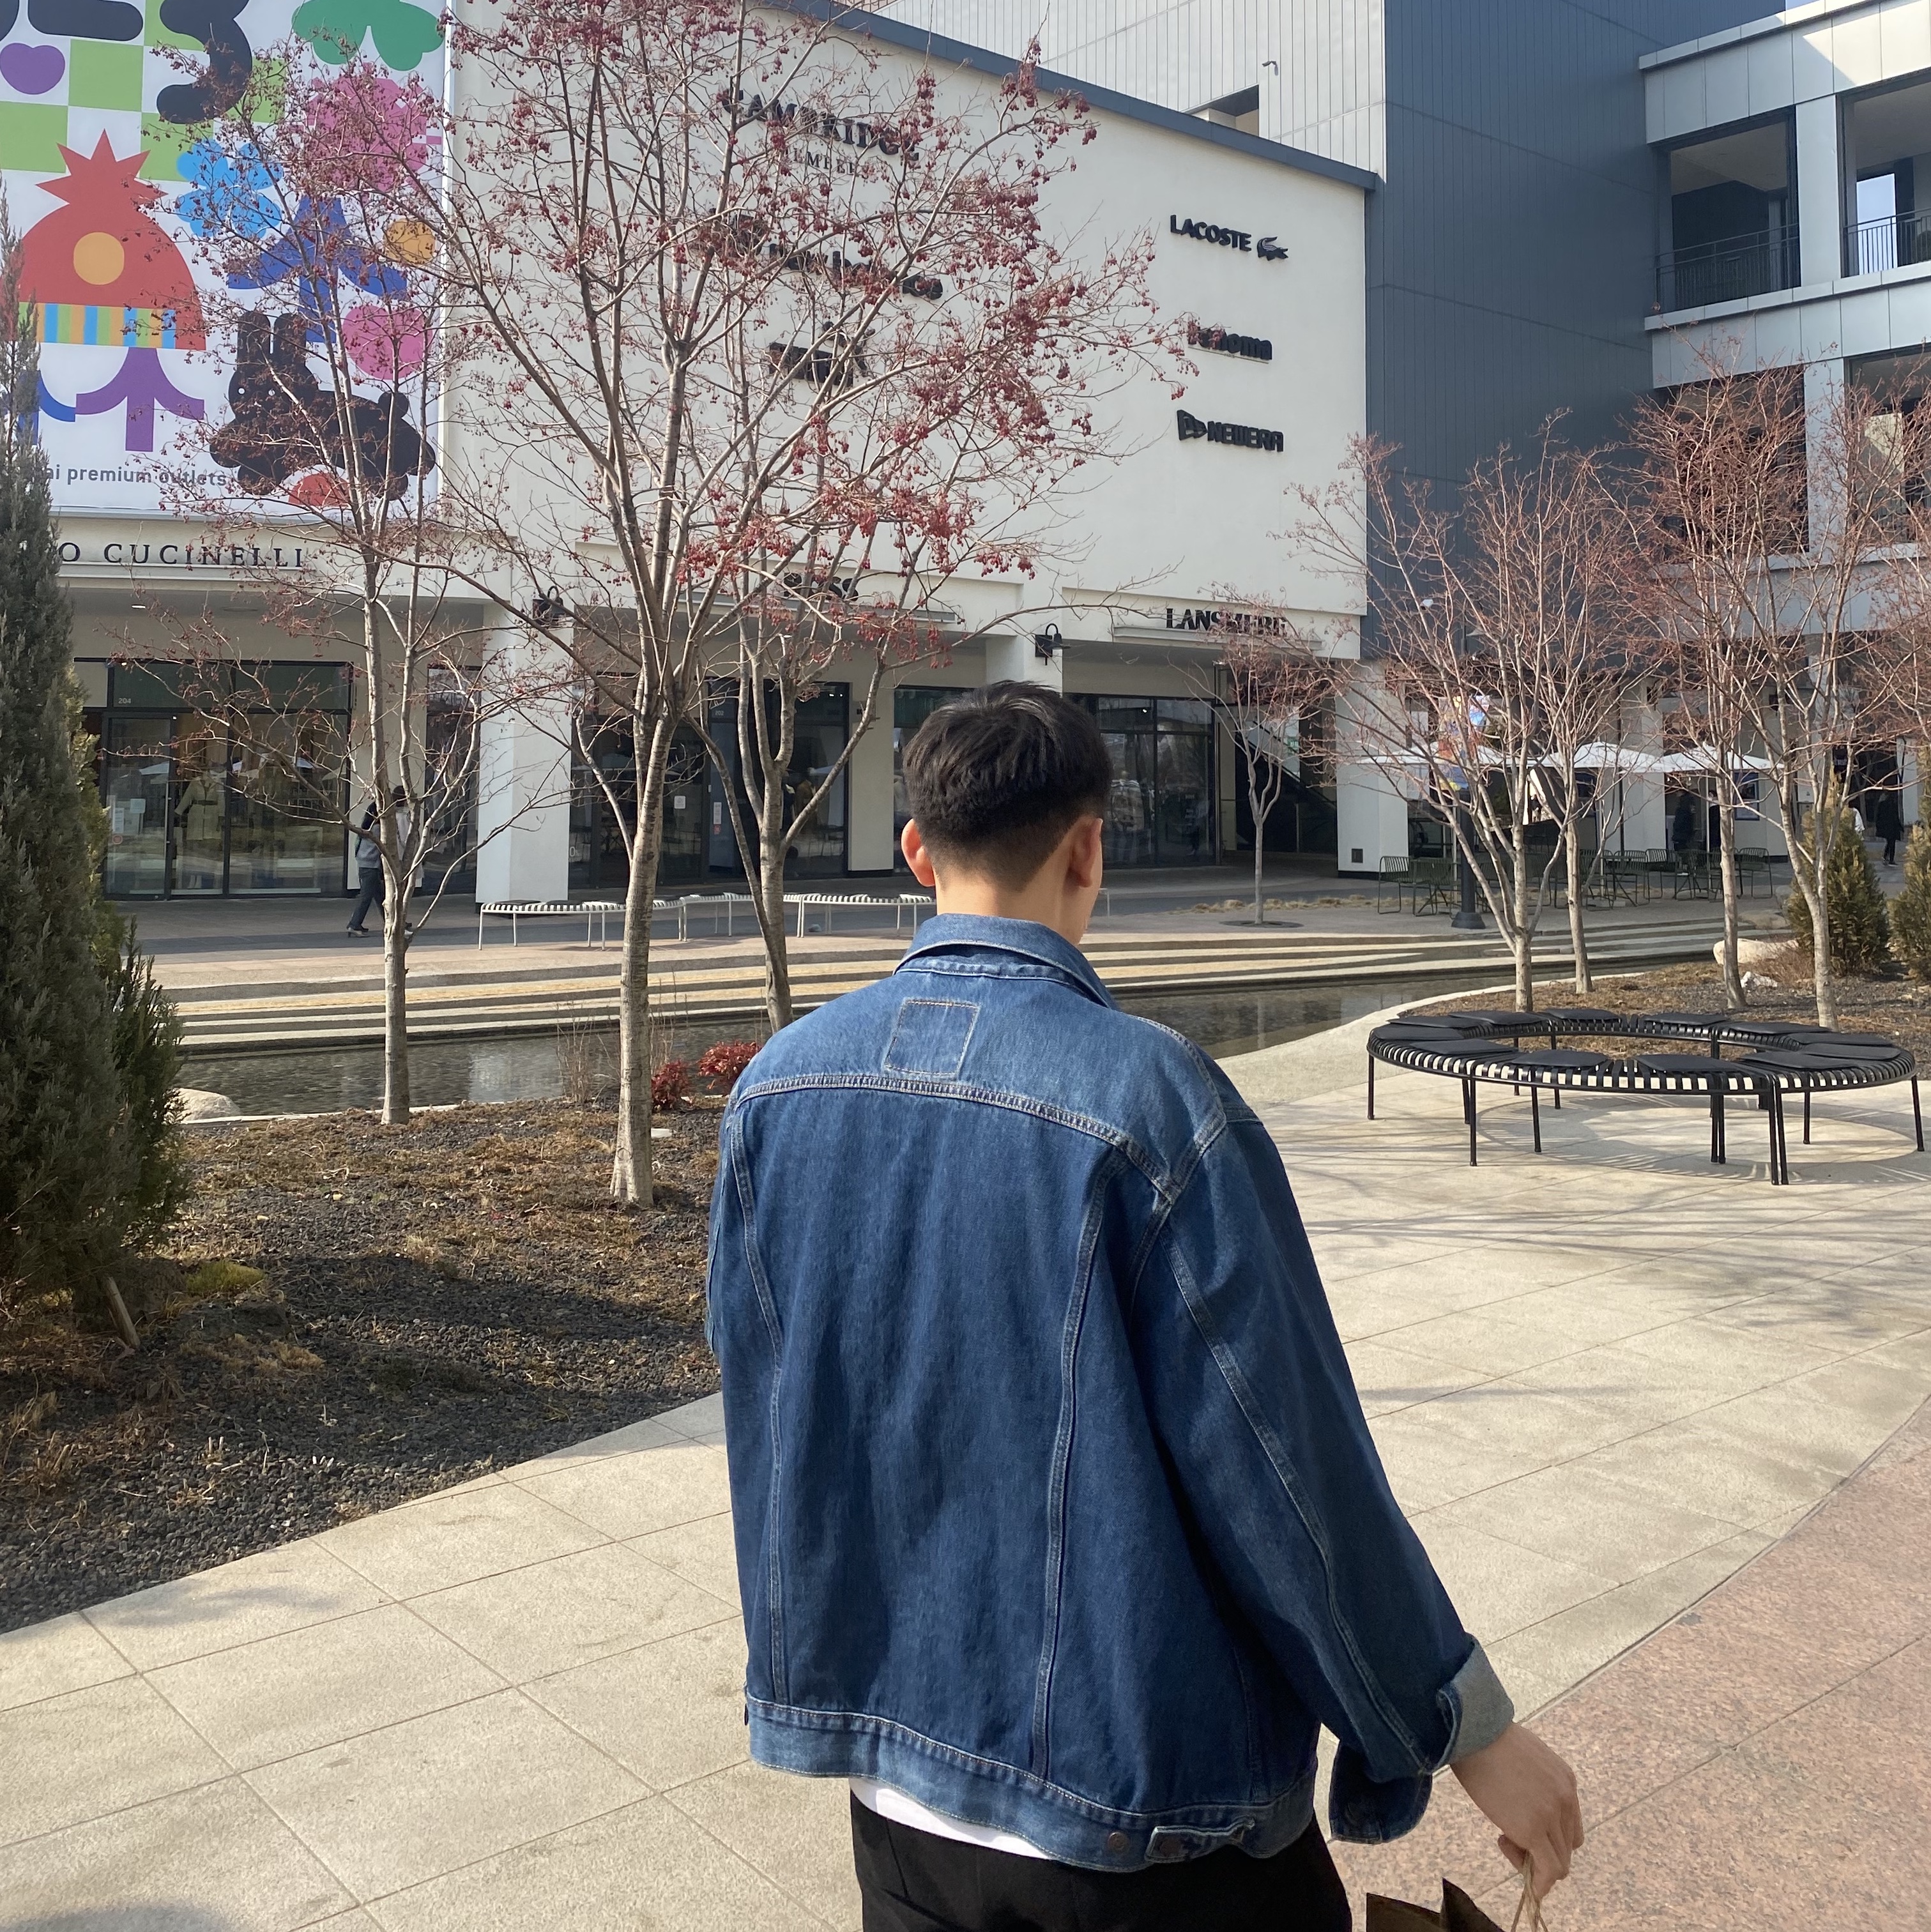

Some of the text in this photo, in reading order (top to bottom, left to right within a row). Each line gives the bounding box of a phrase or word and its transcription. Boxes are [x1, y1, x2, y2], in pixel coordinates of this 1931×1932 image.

[1170, 215, 1251, 251] LACOSTE
[67, 466, 152, 485] premium
[160, 469, 227, 487] outlets
[103, 543, 303, 568] CUCINELLI
